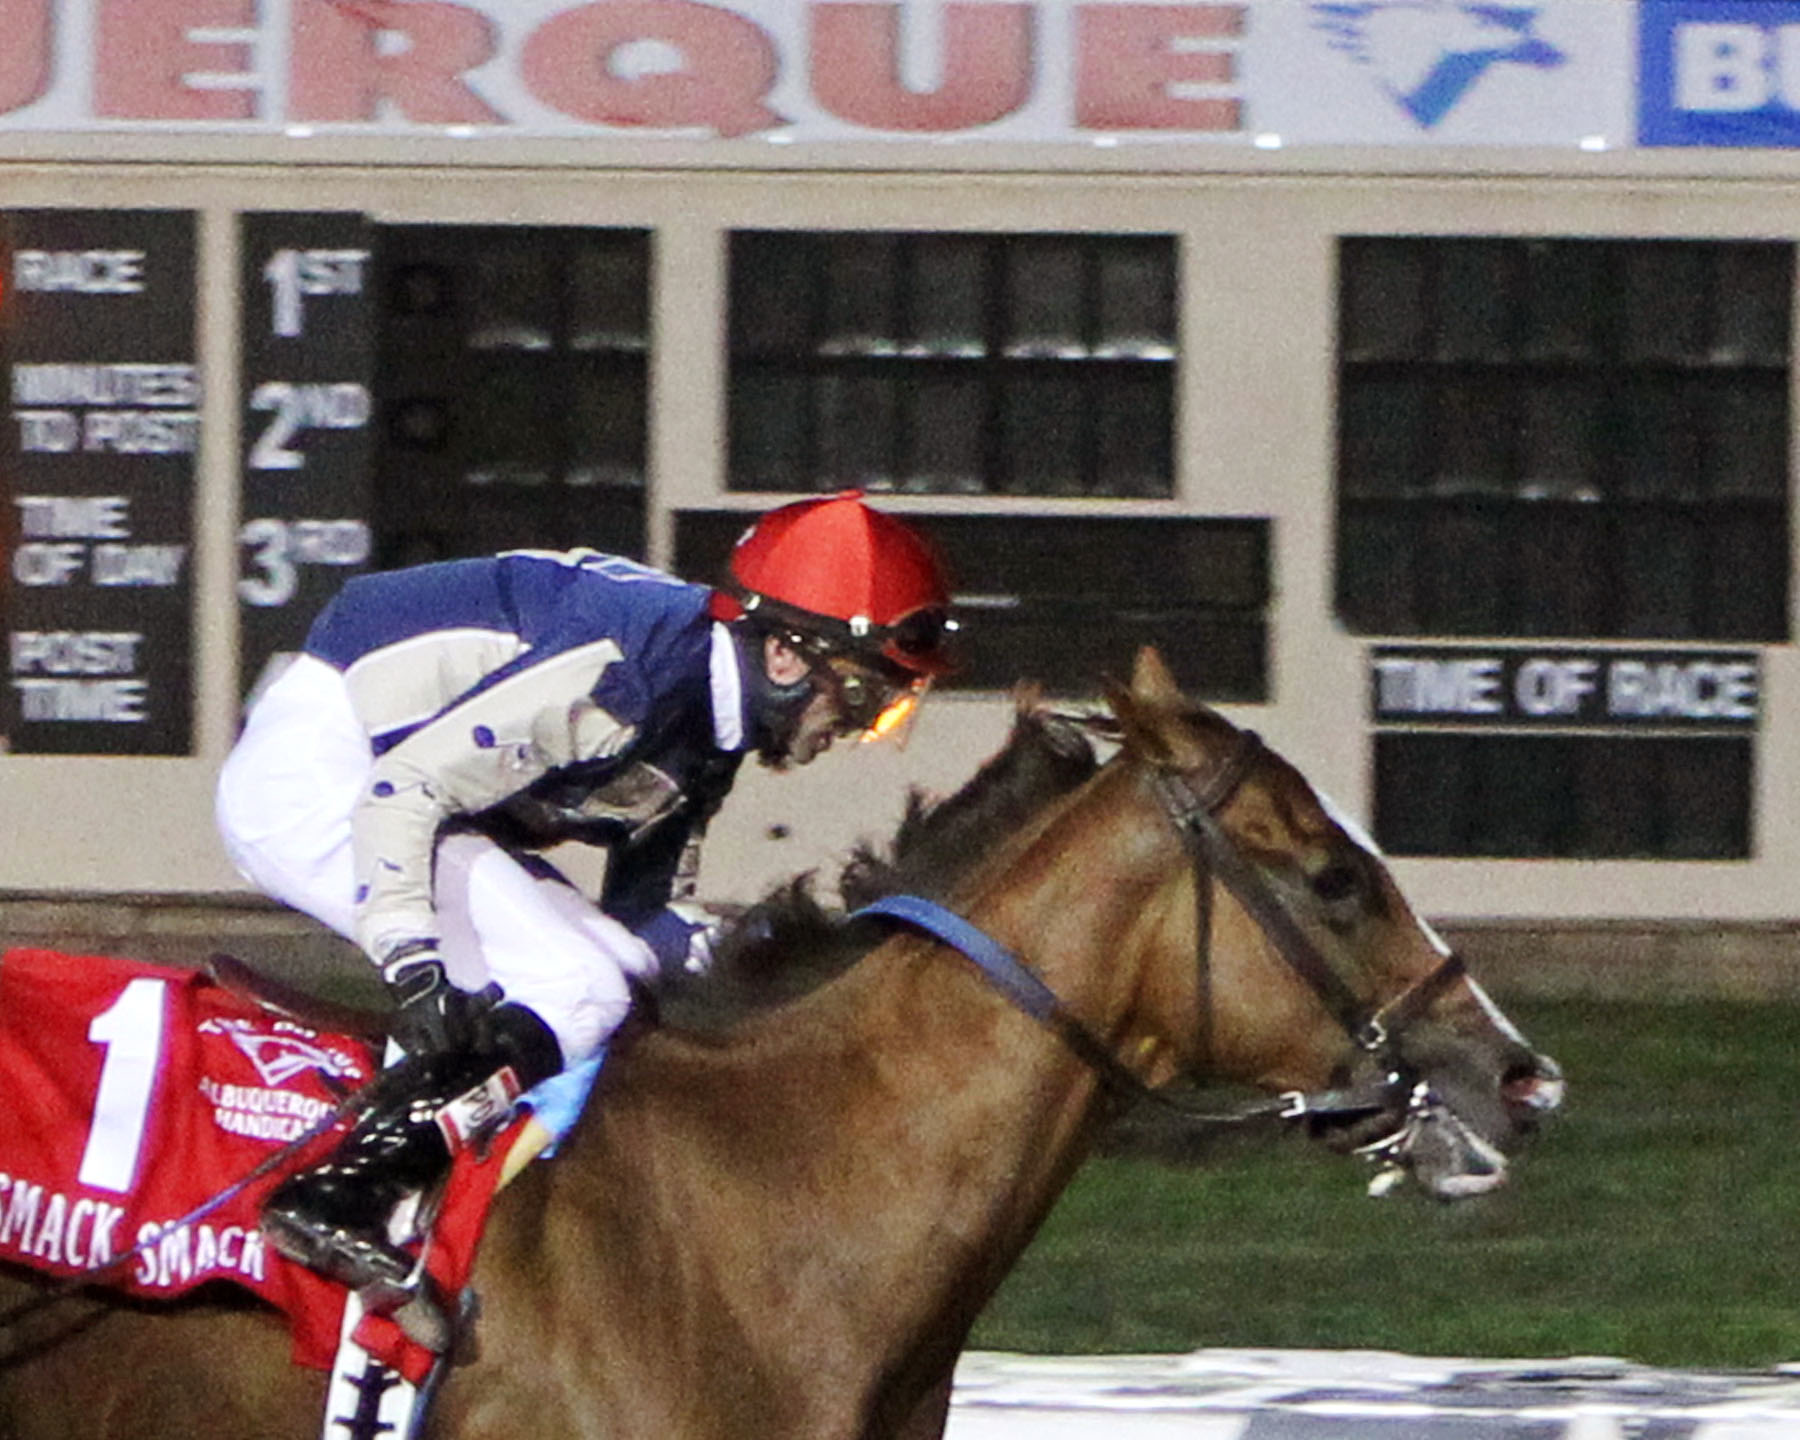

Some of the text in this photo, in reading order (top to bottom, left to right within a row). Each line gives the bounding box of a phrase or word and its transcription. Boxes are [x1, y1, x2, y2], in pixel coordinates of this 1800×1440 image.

[1672, 22, 1800, 111] B
[11, 249, 146, 293] RACE
[262, 249, 372, 336] 1ST
[10, 364, 198, 405] MINUTES
[11, 411, 200, 455] TO POST
[250, 382, 372, 470] 2ND
[12, 496, 131, 538] TIME
[12, 542, 187, 587] OF DAY
[238, 518, 372, 606] 3RD
[9, 630, 144, 674] POST
[10, 678, 148, 723] TIME
[1374, 657, 1759, 719] TIME OF RACE
[78, 977, 168, 1193] 1
[135, 1219, 265, 1287] SMACK
